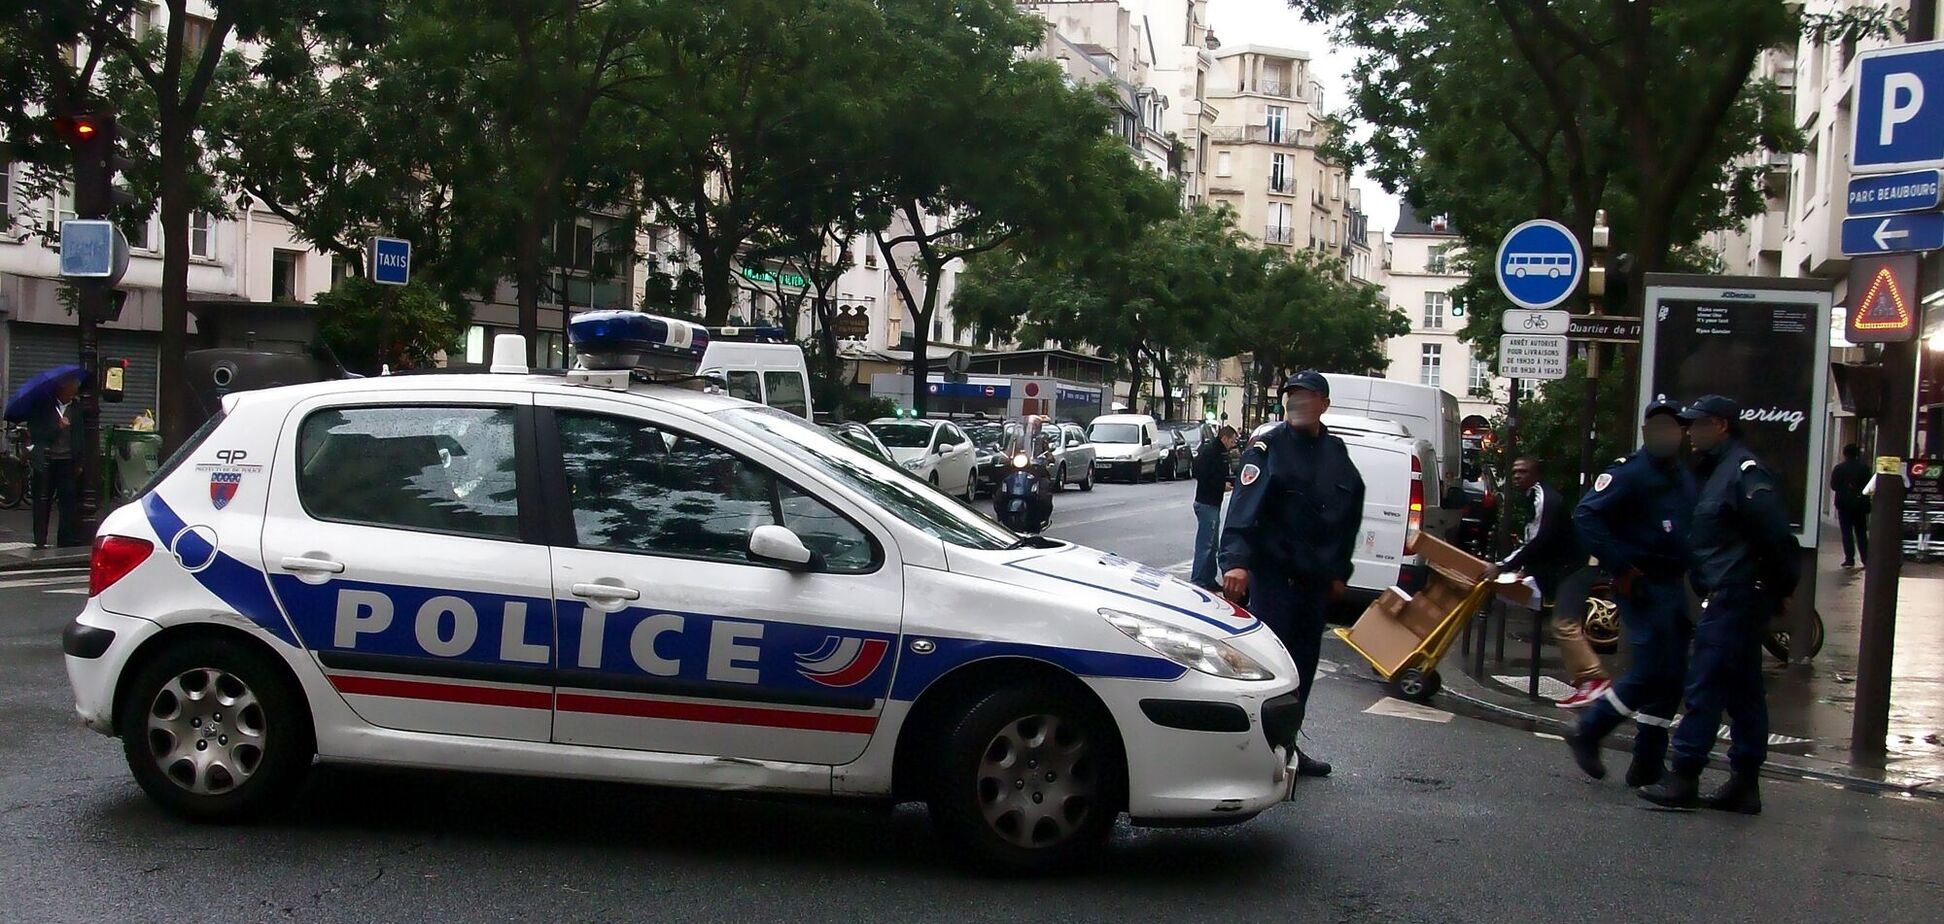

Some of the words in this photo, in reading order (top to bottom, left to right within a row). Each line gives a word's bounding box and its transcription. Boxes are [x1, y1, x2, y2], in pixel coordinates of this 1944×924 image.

[1879, 72, 1924, 146] P
[1849, 189, 1874, 203] PARC
[1877, 183, 1937, 201] BEAUBOURG
[379, 253, 407, 268] TAXIS
[1569, 322, 1609, 334] Quartier
[1613, 325, 1625, 335] de
[333, 588, 764, 684] POLICE
